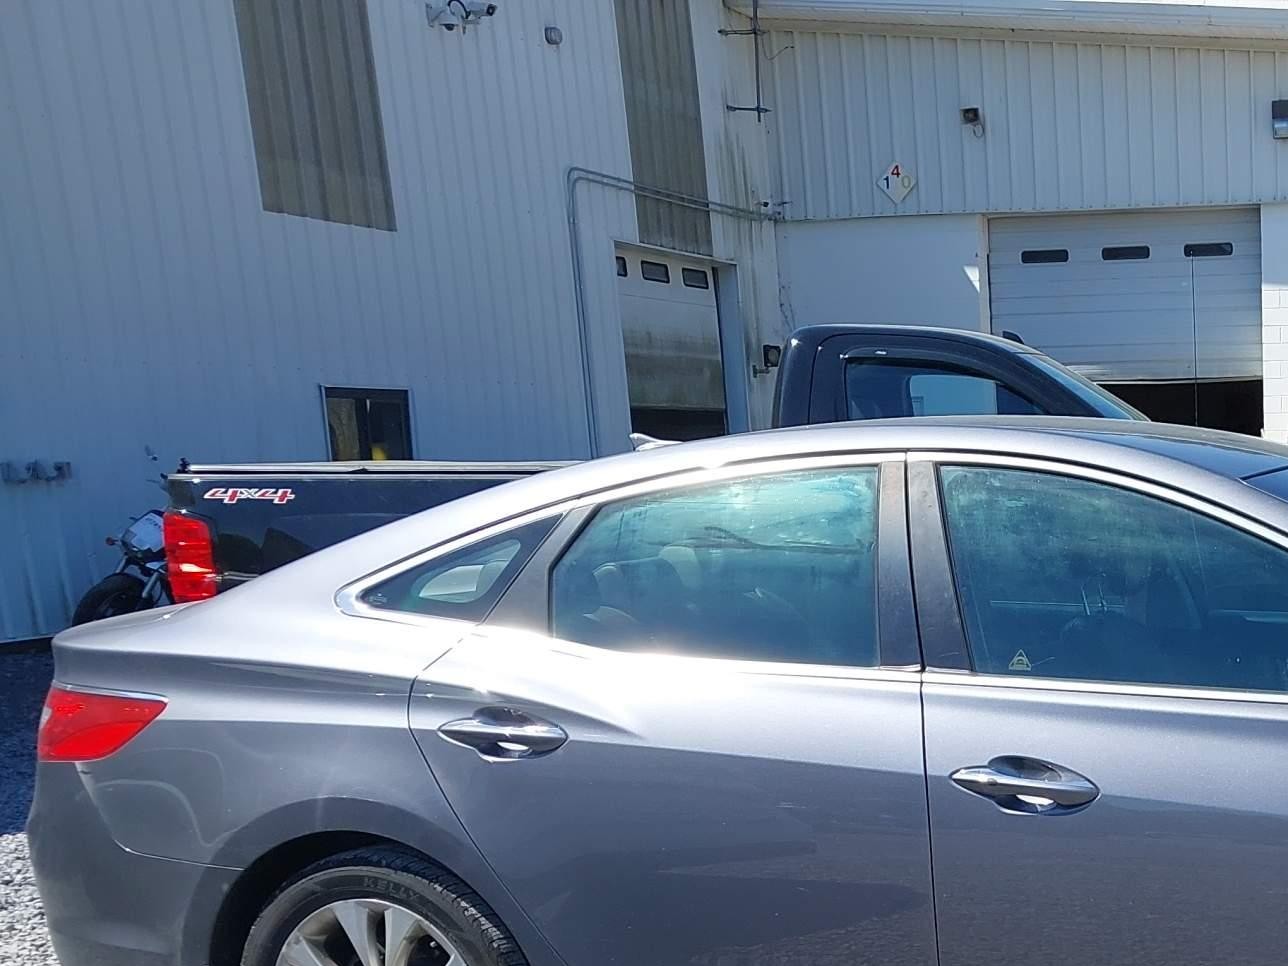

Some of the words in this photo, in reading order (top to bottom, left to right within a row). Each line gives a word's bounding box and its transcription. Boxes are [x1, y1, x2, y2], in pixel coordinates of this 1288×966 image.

[891, 164, 901, 178] 4
[883, 175, 890, 189] 1
[901, 175, 911, 189] 0
[203, 487, 296, 504] 4x4
[364, 876, 420, 900] KELLY
